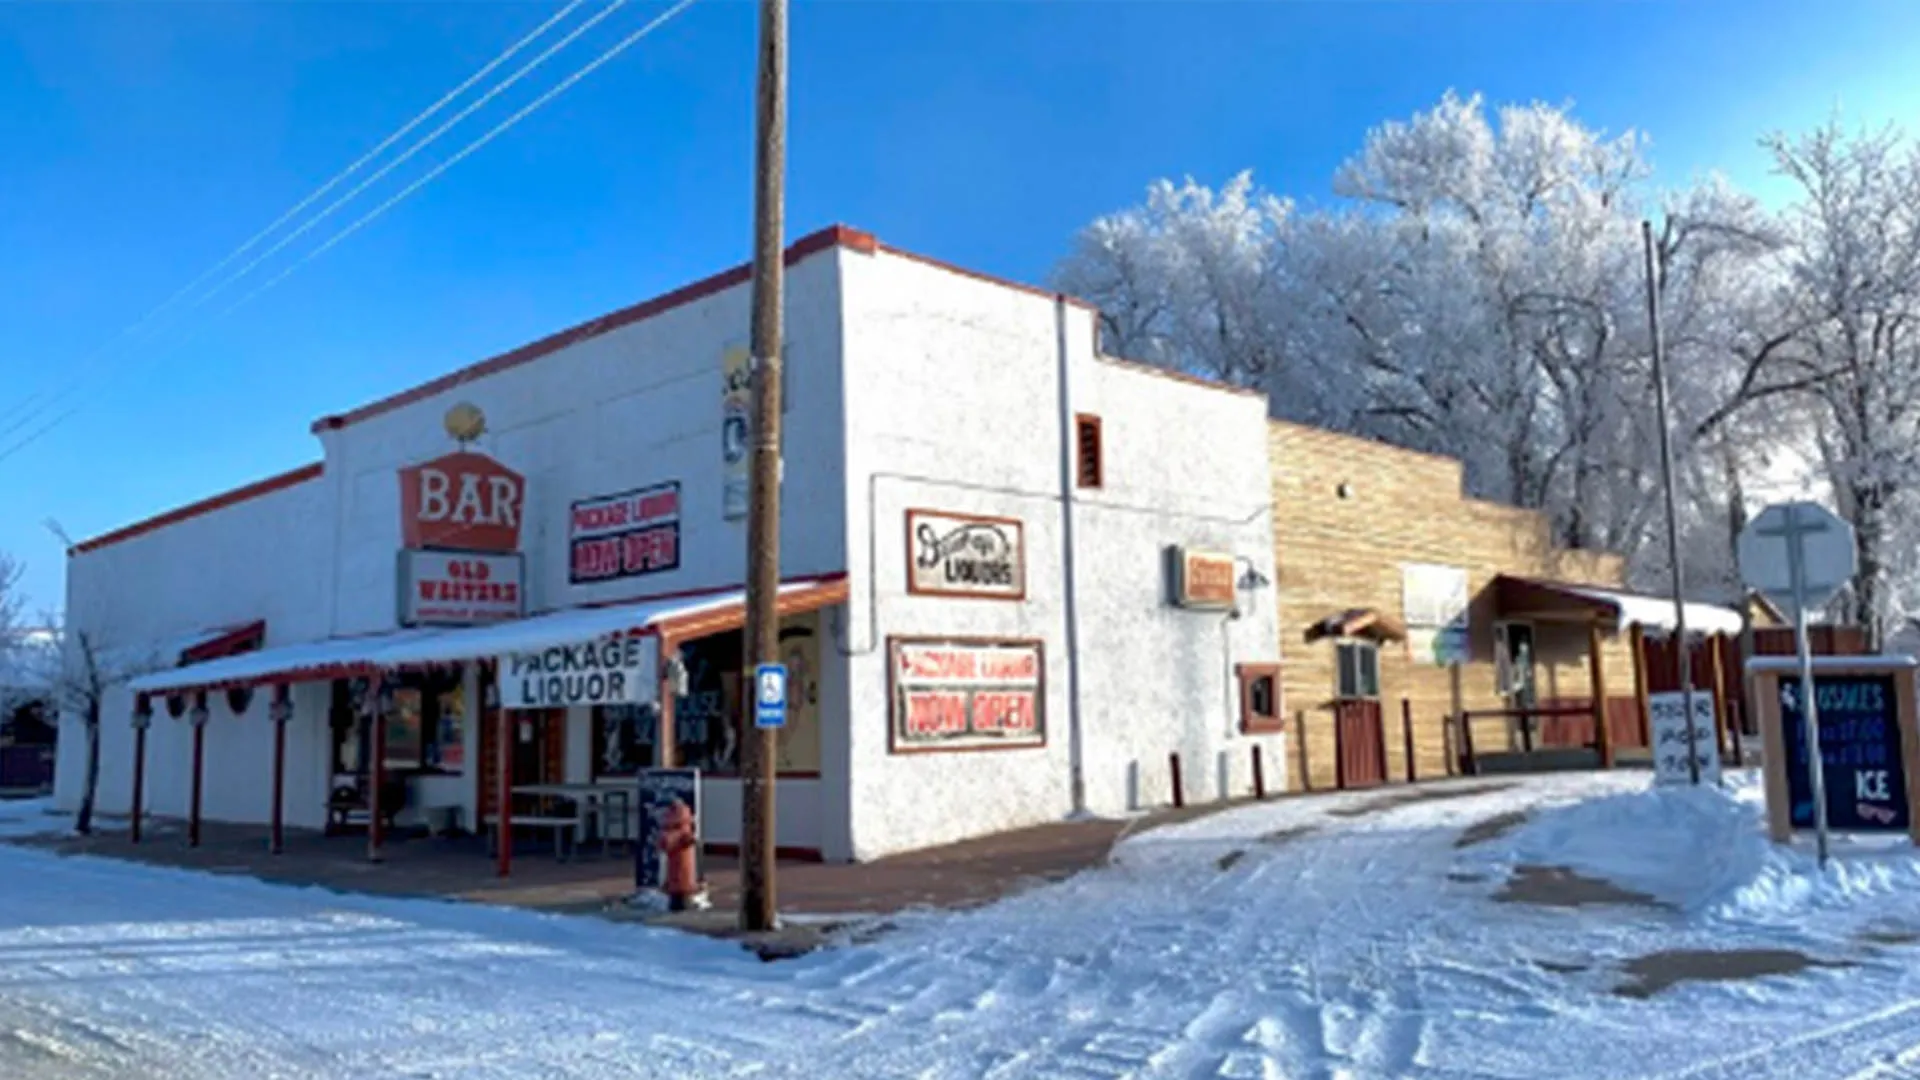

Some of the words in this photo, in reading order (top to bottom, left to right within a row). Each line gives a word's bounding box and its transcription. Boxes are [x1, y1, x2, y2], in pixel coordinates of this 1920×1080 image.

[418, 469, 518, 527] BAR
[575, 538, 620, 575] NOW
[624, 528, 676, 568] OPEN
[448, 559, 490, 580] OLD
[944, 558, 1013, 585] LIQUORS
[508, 639, 642, 676] PACKAGE
[522, 671, 626, 705] LIQUOR
[907, 691, 967, 731] NOW
[972, 691, 1035, 730] OPEN
[1856, 770, 1891, 801] ICE
